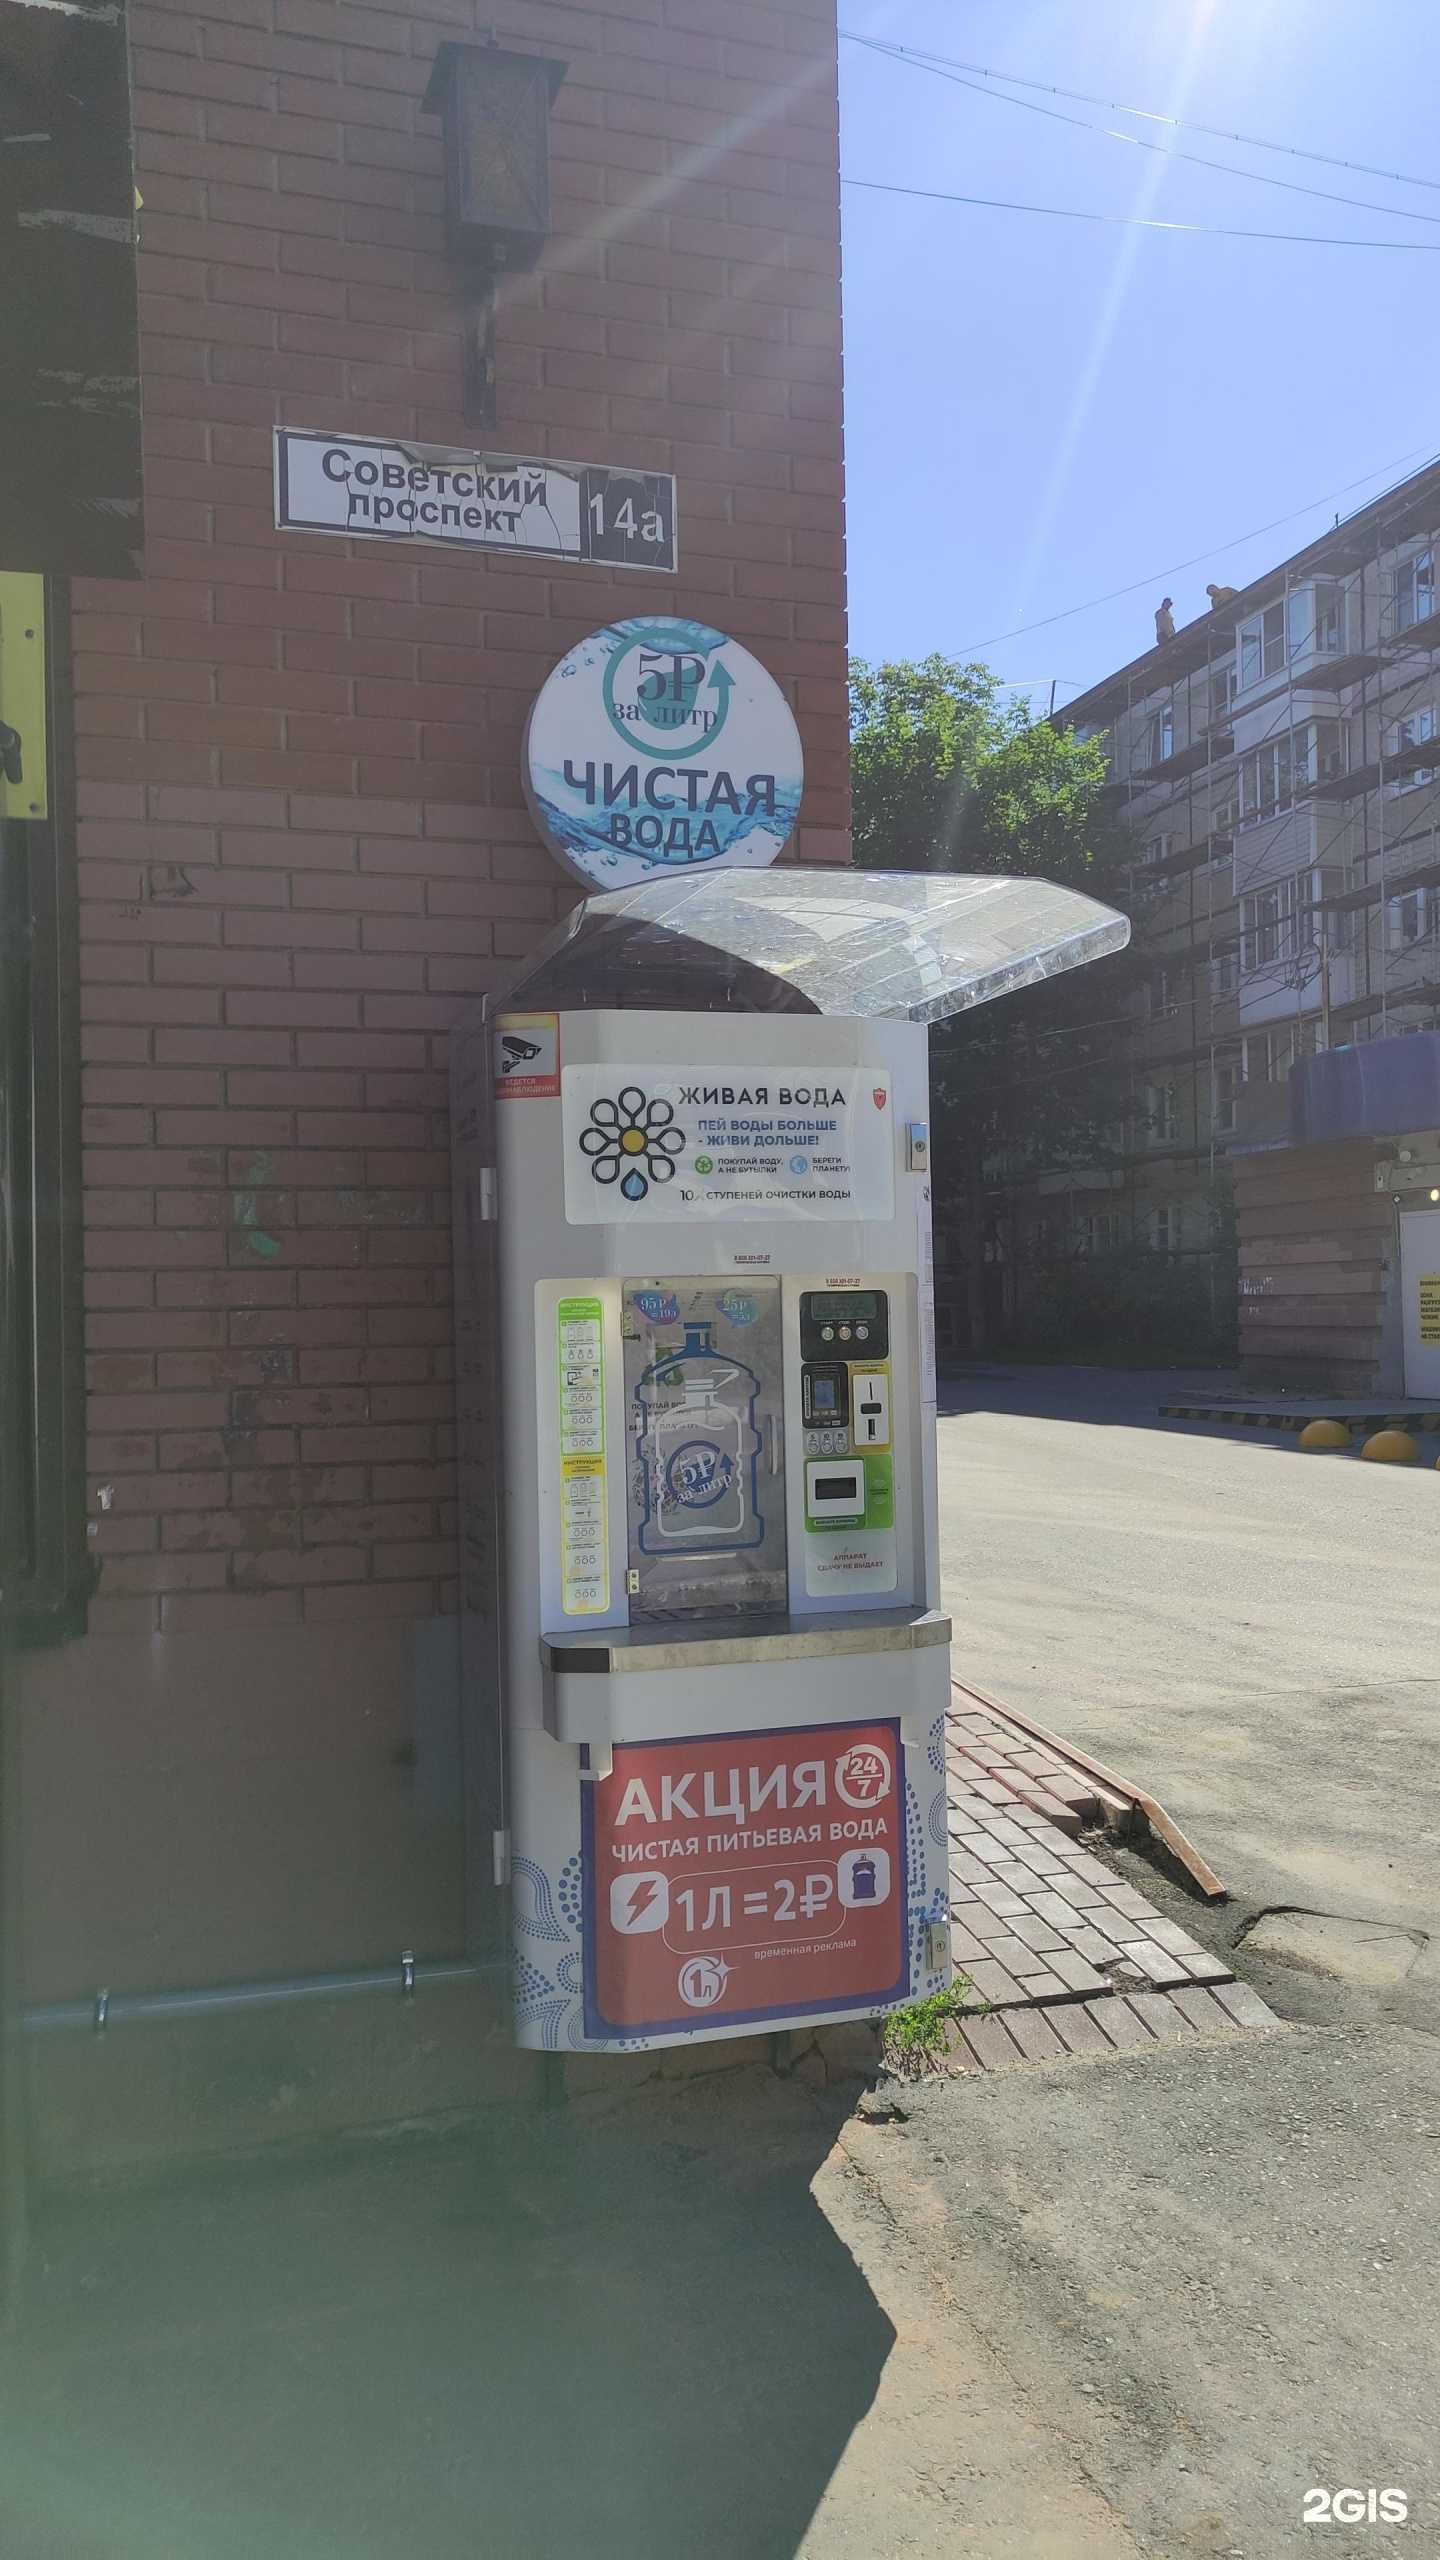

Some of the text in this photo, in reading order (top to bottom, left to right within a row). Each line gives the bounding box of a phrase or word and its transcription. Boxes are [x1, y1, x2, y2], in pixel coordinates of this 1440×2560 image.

[321, 448, 547, 507] Советский
[348, 491, 522, 534] проспект
[588, 493, 666, 543] 14а
[613, 703, 718, 734] за литр
[563, 760, 777, 817] ЧИСТАЯ
[610, 813, 721, 859] ВОДА
[678, 1087, 847, 1108] ЖИВАЯ ВОДА
[698, 1118, 838, 1132] ПЕЙ ВОДЫ БОЛЬШЕ
[706, 1135, 750, 1146] ЖИВИ
[753, 1135, 819, 1148] ДОЛЬШЕ!
[718, 1157, 757, 1165] ПОКУПАЙ
[706, 1190, 763, 1200] СТУПЕНЕЙ
[765, 1190, 816, 1200] ОЧИСТКИ
[818, 1190, 851, 1200] ВОДЫ
[850, 1756, 879, 1776] 24
[614, 1760, 827, 1827] АКЦИЯ
[612, 1817, 889, 1865] ЧИСТАЯ ПИТЬЕВАЯ ВОДА
[753, 1938, 857, 1961] временная реклама
